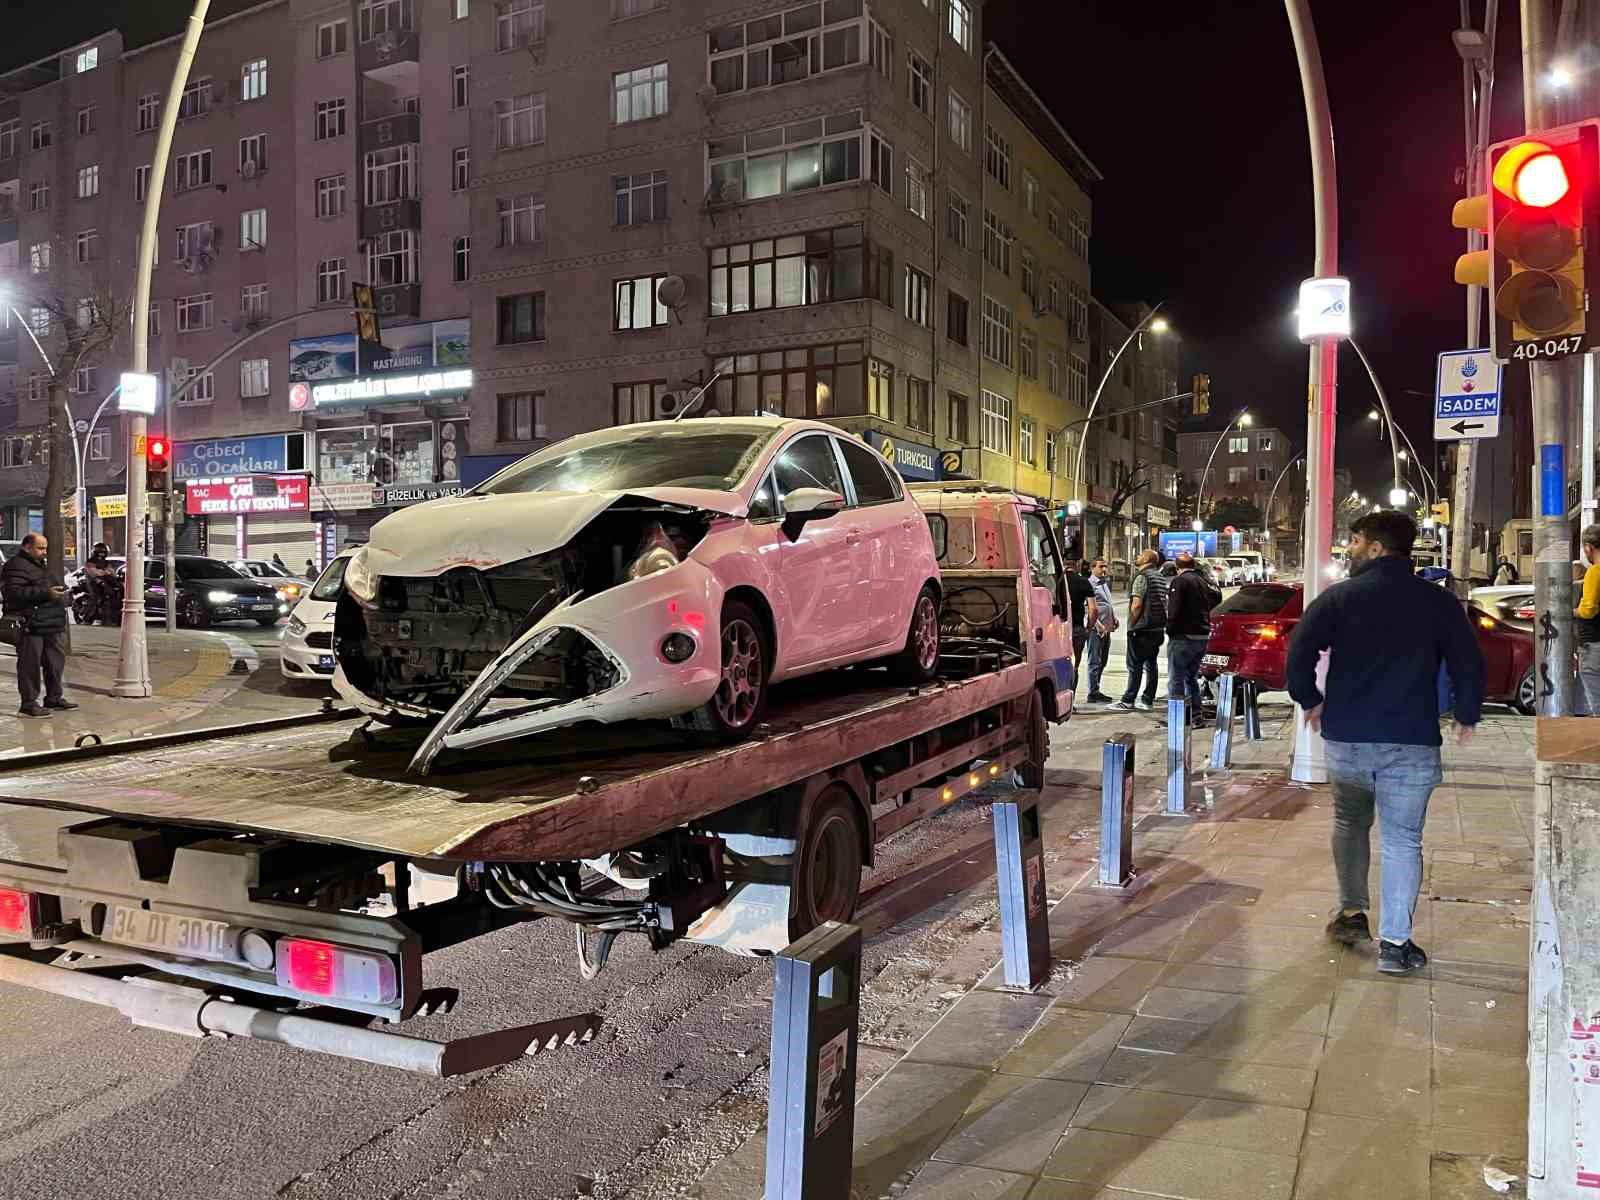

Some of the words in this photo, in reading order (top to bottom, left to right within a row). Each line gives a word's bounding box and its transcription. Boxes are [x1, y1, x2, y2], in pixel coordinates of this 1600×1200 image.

[1513, 336, 1582, 360] 40-047
[373, 355, 423, 370] KASTAMONU
[1438, 397, 1497, 413] İSADEM
[897, 448, 934, 470] TURKCELL
[387, 488, 424, 500] GÜZELLİK
[427, 491, 437, 499] ve
[114, 909, 137, 939] 34
[146, 914, 171, 945] DT
